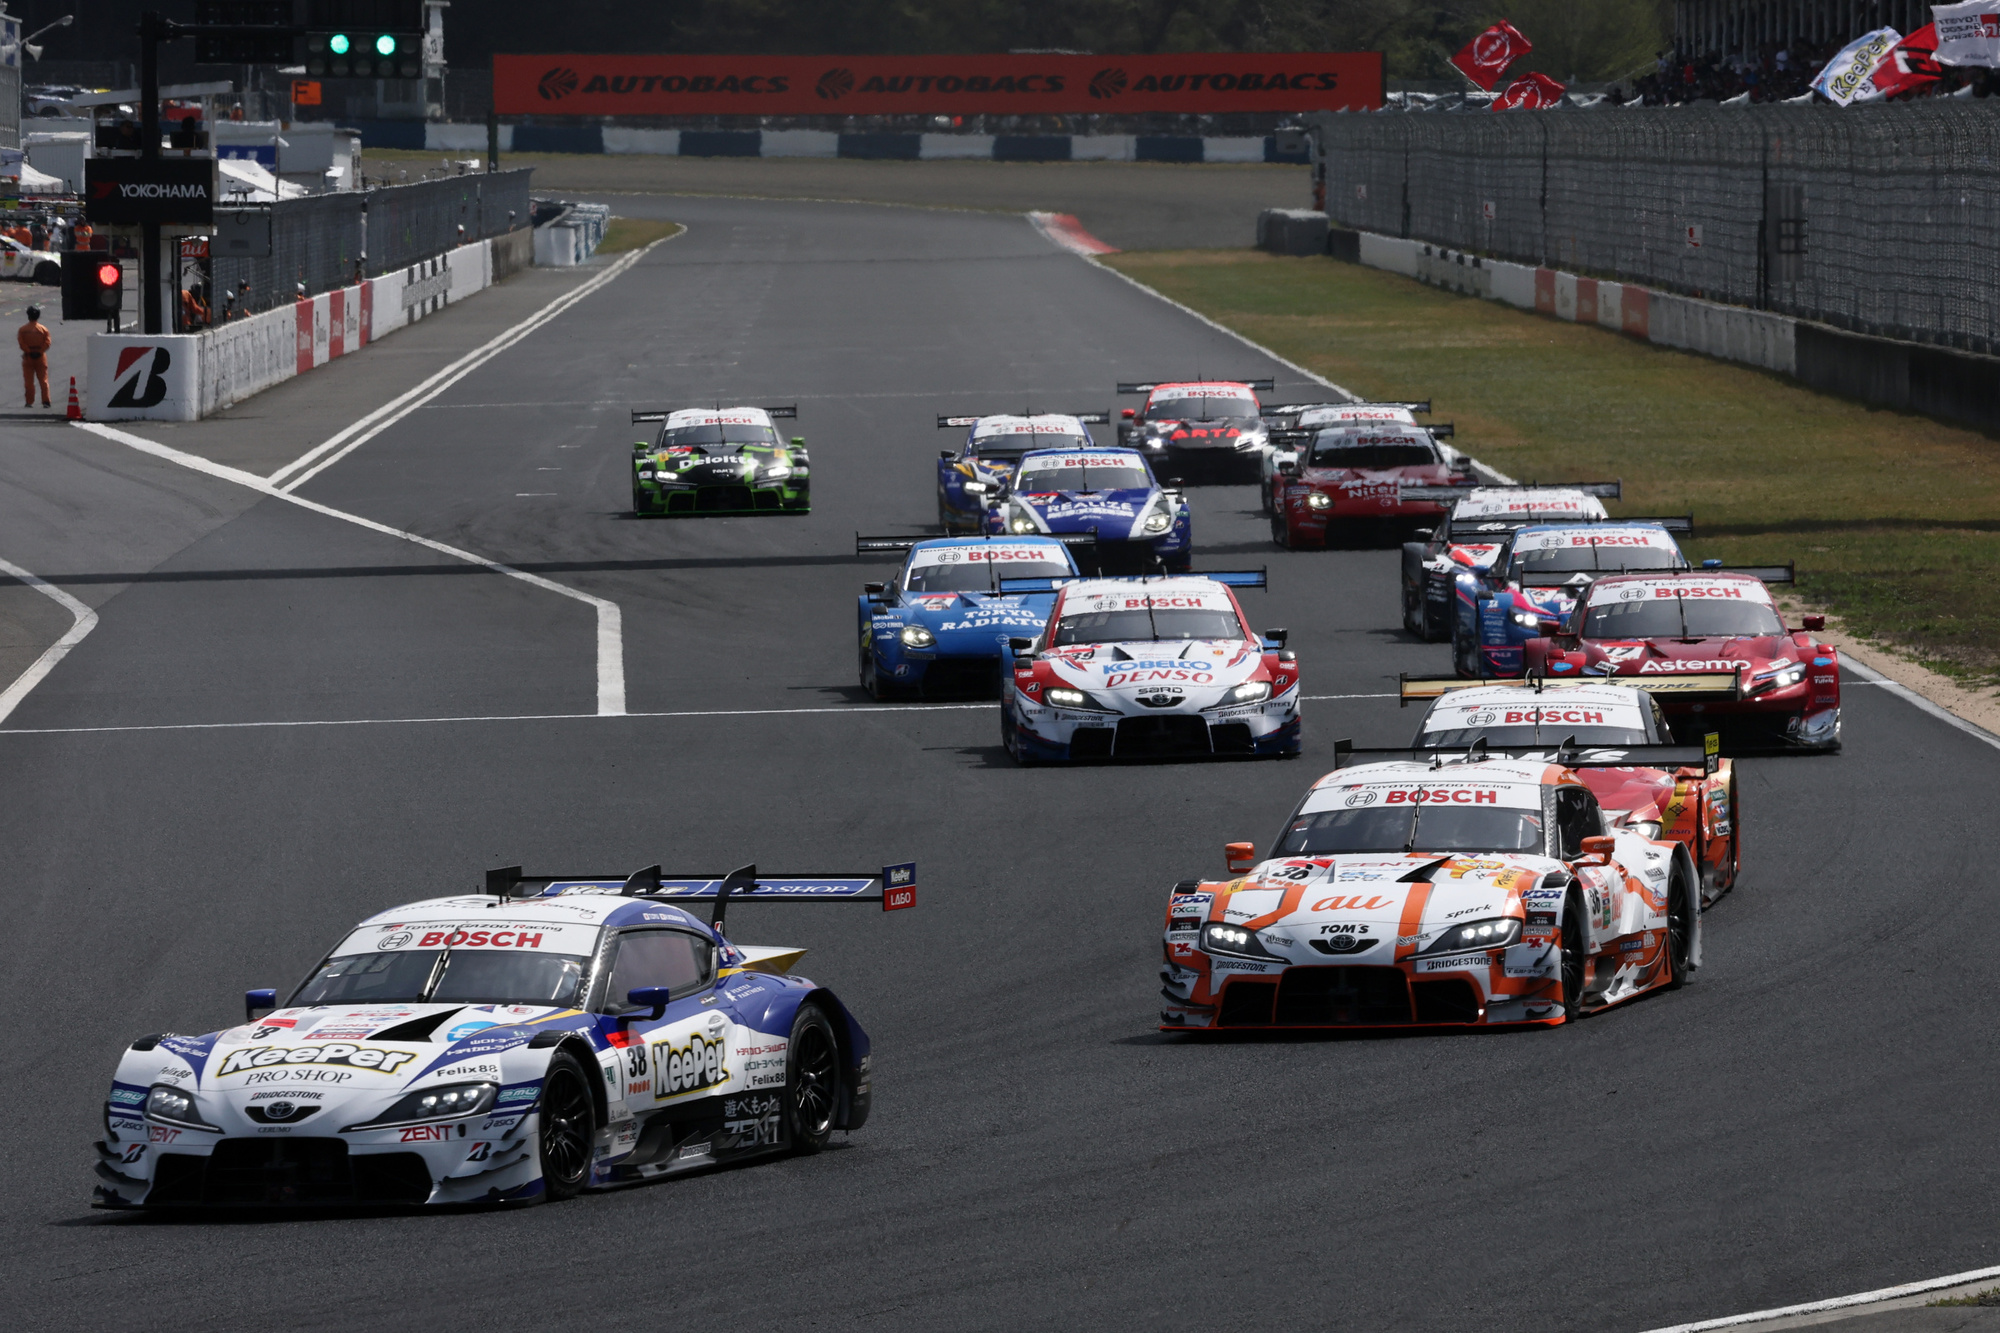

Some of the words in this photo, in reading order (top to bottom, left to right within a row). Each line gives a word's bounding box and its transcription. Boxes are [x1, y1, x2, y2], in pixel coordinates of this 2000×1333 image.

[1831, 33, 1888, 101] KeePer
[581, 75, 789, 94] AUTOBACS
[857, 74, 1066, 94] AUTOBACS
[1133, 72, 1338, 92] AUTOBACS
[119, 184, 207, 198] YOKOHAMA
[1170, 428, 1242, 440] ARTA
[1357, 436, 1416, 445] BOSCH
[1065, 459, 1126, 467] BOSCH
[1047, 501, 1134, 513] REALIZE
[1509, 502, 1578, 511] BOSCH
[1572, 536, 1649, 545] BOSCH
[969, 550, 1045, 562] BOSCH
[1655, 587, 1742, 599] BOSCH
[1125, 598, 1202, 608] BOSCH
[964, 609, 1035, 619] TOKYO
[940, 616, 1047, 631] RADIATO
[1103, 659, 1213, 675] KOBELCO
[1639, 658, 1752, 673] Astemo
[1106, 669, 1214, 688] DENSO
[1575, 704, 1614, 712] Racing
[1504, 711, 1604, 723] BOSCH
[1385, 790, 1497, 804] BOSCH
[774, 885, 849, 893] SHOP
[1522, 890, 1563, 899] KDDI
[890, 893, 912, 905] LABO
[1171, 895, 1212, 904] KDDI
[1311, 895, 1394, 912] au
[1220, 909, 1258, 919] spark
[1445, 904, 1492, 918] spark
[404, 923, 455, 931] TOYOTA
[513, 924, 563, 932] Racing
[1320, 924, 1369, 934] TOM'S
[417, 931, 544, 949] BOSCH
[1216, 960, 1267, 972] BRIDGESTONE
[1427, 957, 1492, 970] BRIDGESTONE
[216, 1043, 418, 1079] KeePer
[627, 1046, 647, 1077] 38
[653, 1032, 729, 1100] KeePer
[245, 1070, 288, 1085] PRO
[291, 1069, 352, 1083] SHOP
[437, 1065, 498, 1077] Felix88
[752, 1072, 785, 1086] Felix88
[628, 1079, 650, 1095] PONOS
[251, 1091, 325, 1101] BRIDGESTONE
[122, 1122, 144, 1131] asics
[150, 1126, 182, 1143] ZENT
[398, 1125, 453, 1143] ZENT
